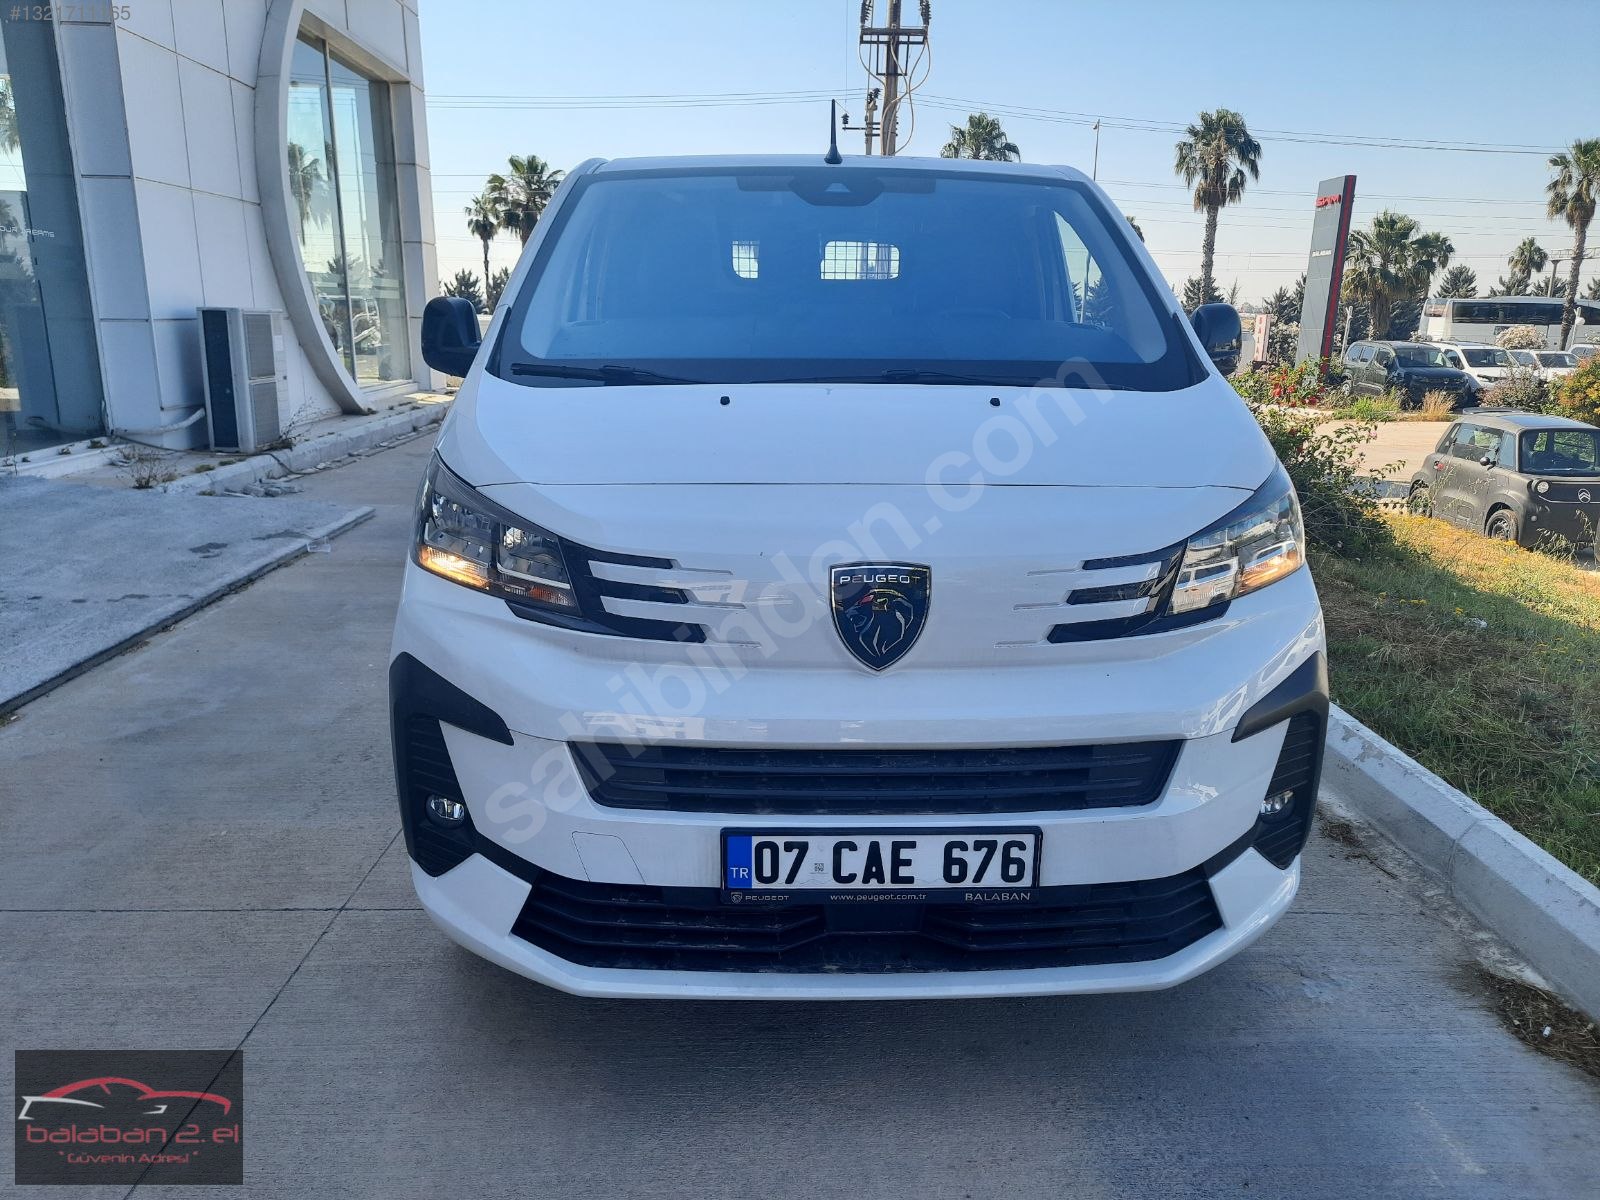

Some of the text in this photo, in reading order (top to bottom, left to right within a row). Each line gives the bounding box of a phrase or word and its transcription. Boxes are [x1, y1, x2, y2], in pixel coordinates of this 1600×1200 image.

[840, 574, 920, 585] PEUGEOT
[754, 840, 1026, 884] 07 CAE 676
[730, 867, 749, 879] TR
[830, 892, 927, 902] www.peugeot.com.tr
[965, 892, 1030, 902] BALABAN
